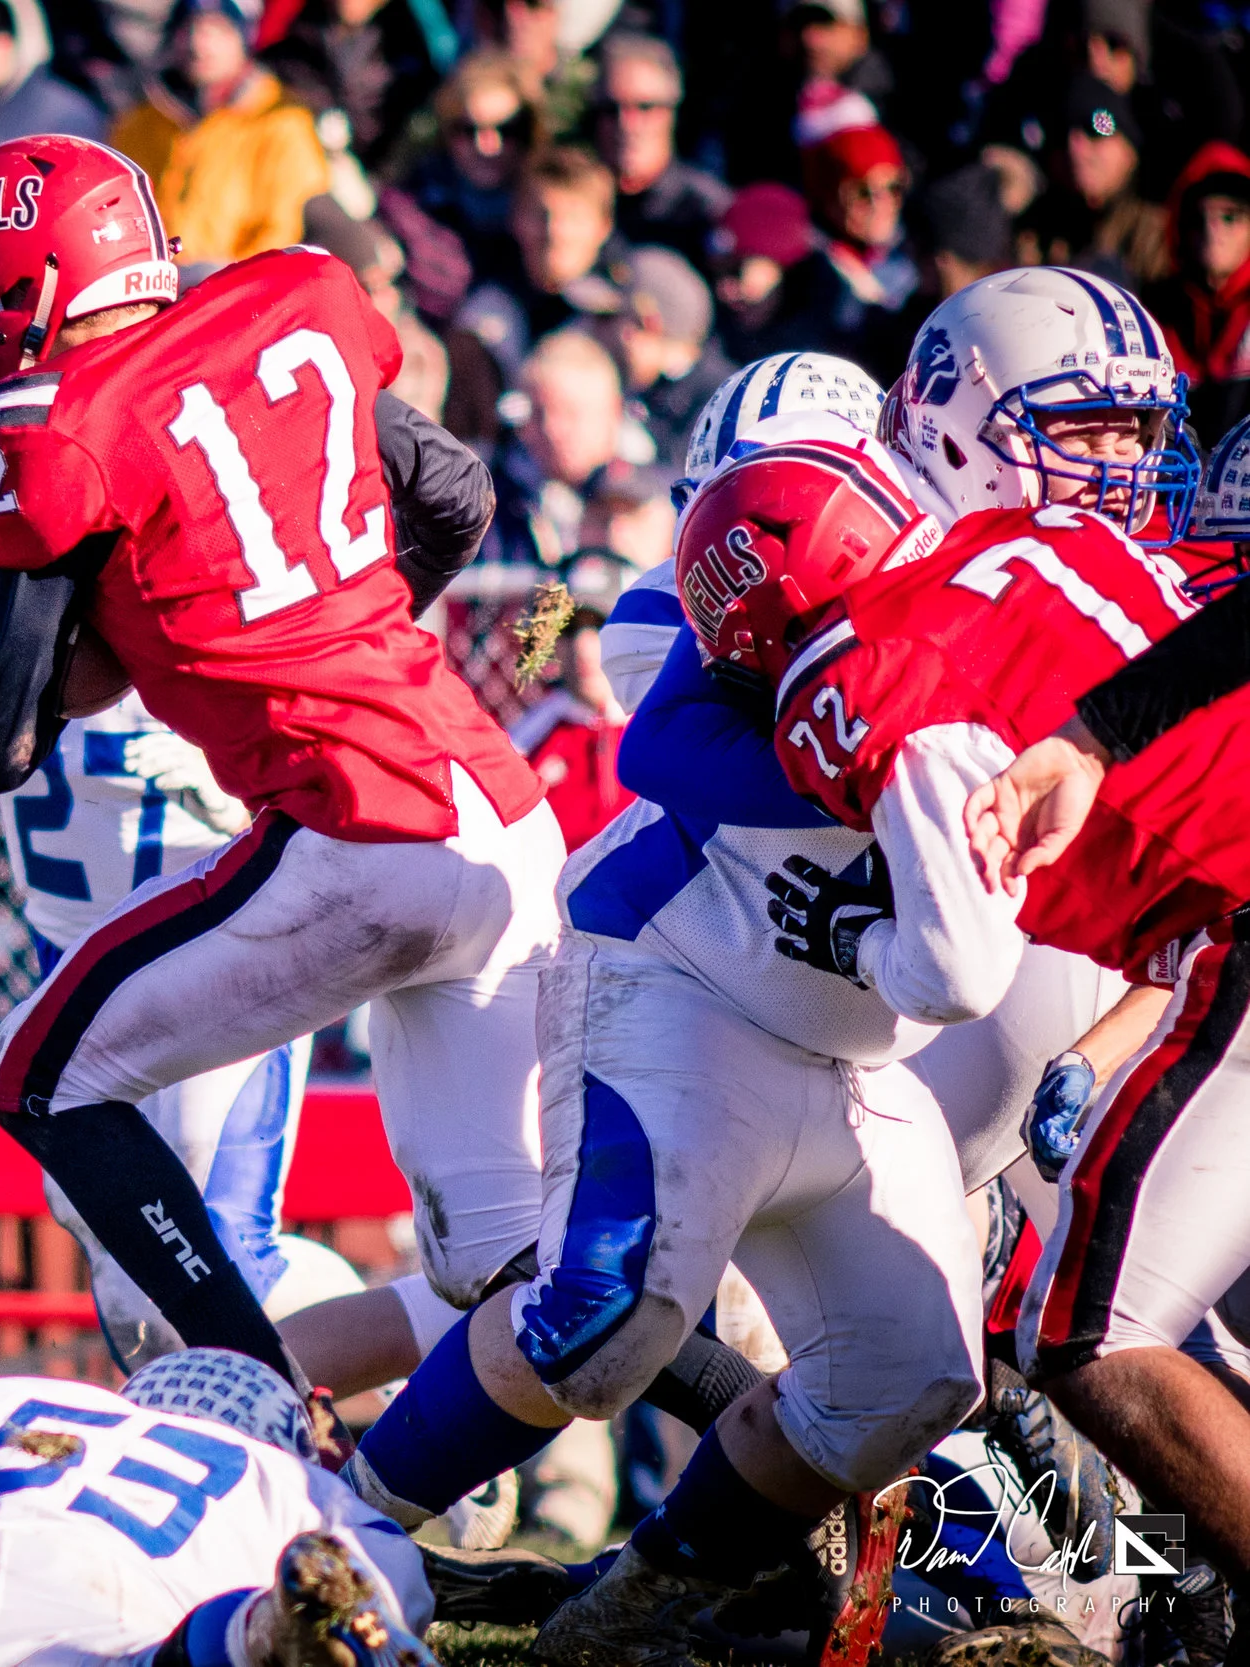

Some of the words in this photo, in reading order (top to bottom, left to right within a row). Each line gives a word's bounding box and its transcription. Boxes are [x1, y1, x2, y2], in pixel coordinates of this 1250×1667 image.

[166, 327, 389, 627] 12
[682, 525, 768, 646] WELLS
[787, 685, 871, 780] 72
[13, 729, 180, 902] 27
